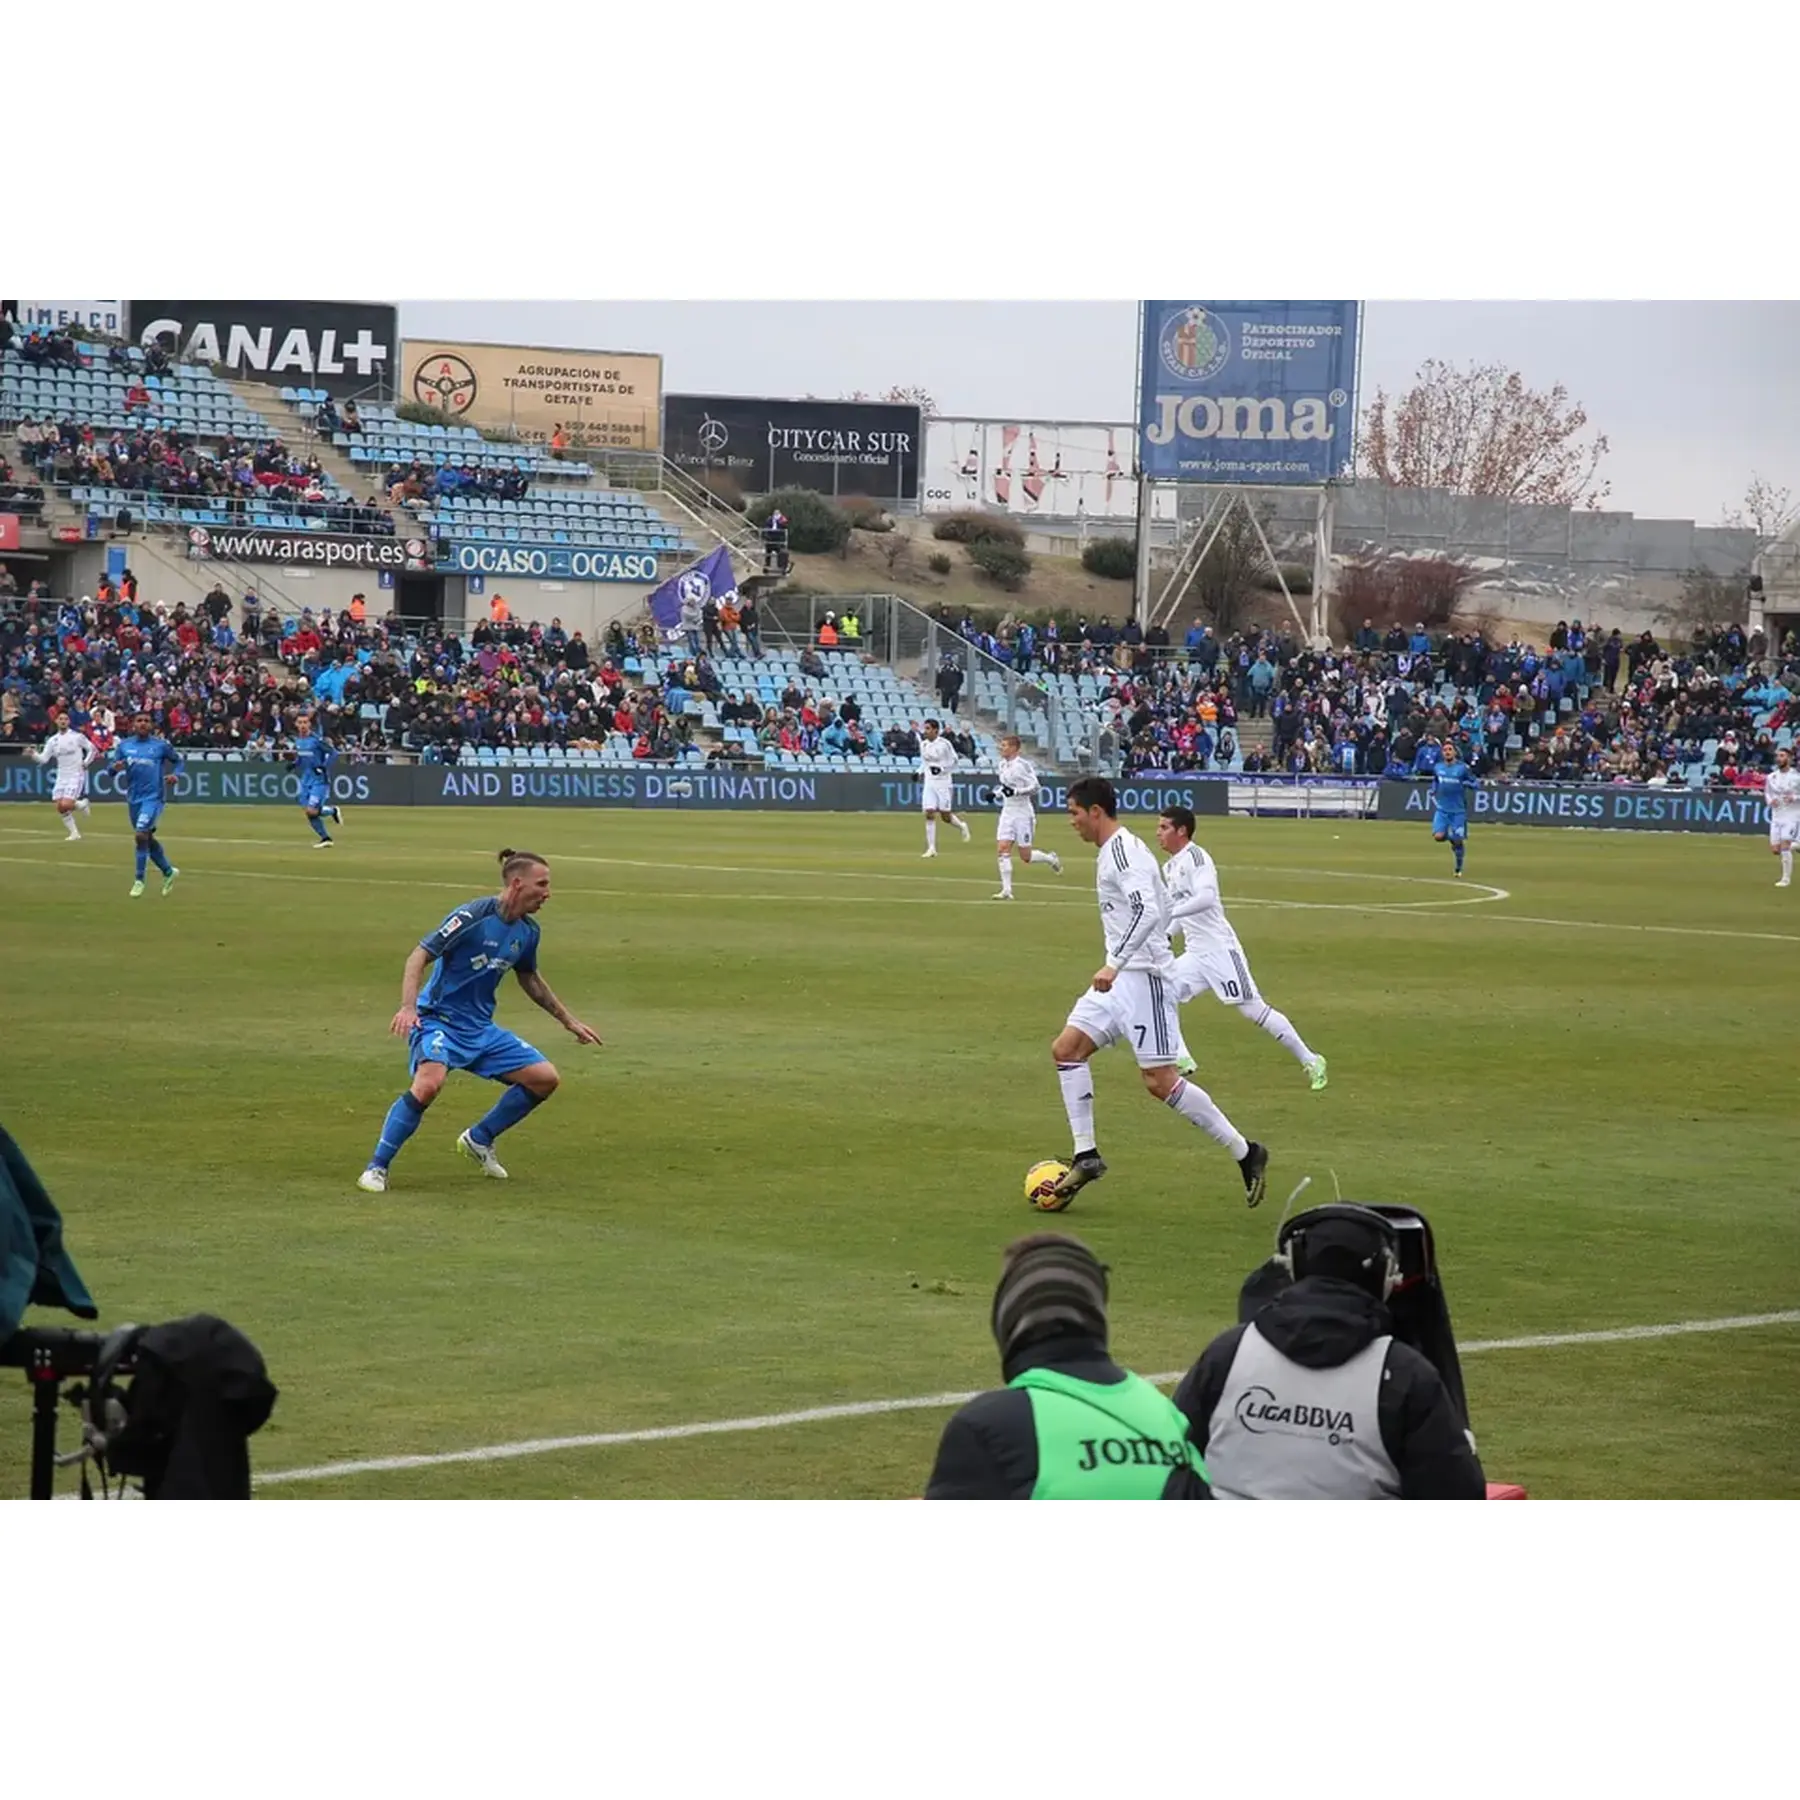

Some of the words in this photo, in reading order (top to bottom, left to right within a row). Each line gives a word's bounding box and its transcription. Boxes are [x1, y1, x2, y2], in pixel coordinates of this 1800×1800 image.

[1242, 322, 1342, 336] PATROCINADOR
[141, 318, 387, 375] CANAL+
[1242, 336, 1316, 348] DEPORTIVO
[1242, 349, 1293, 361] OFICIAL
[518, 365, 600, 379] AGRUPACIÓN
[604, 370, 621, 380] DE
[503, 378, 615, 394] TRANSPORTISTAS
[618, 384, 635, 395] DE
[768, 428, 860, 451] CITYCAR
[868, 431, 911, 453] SUR
[212, 535, 404, 566] www.arasport.es
[459, 546, 546, 575] OCASO
[572, 551, 657, 580] OCASO
[173, 772, 209, 797] DE
[222, 773, 370, 799] NEGOOS
[442, 772, 500, 797] AND
[511, 773, 636, 799] BUSINESS
[1039, 786, 1067, 808] DE
[1474, 790, 1605, 818] BUSINESS
[1220, 979, 1239, 998] 10
[432, 1030, 445, 1047] 2
[1134, 1025, 1147, 1049] 7
